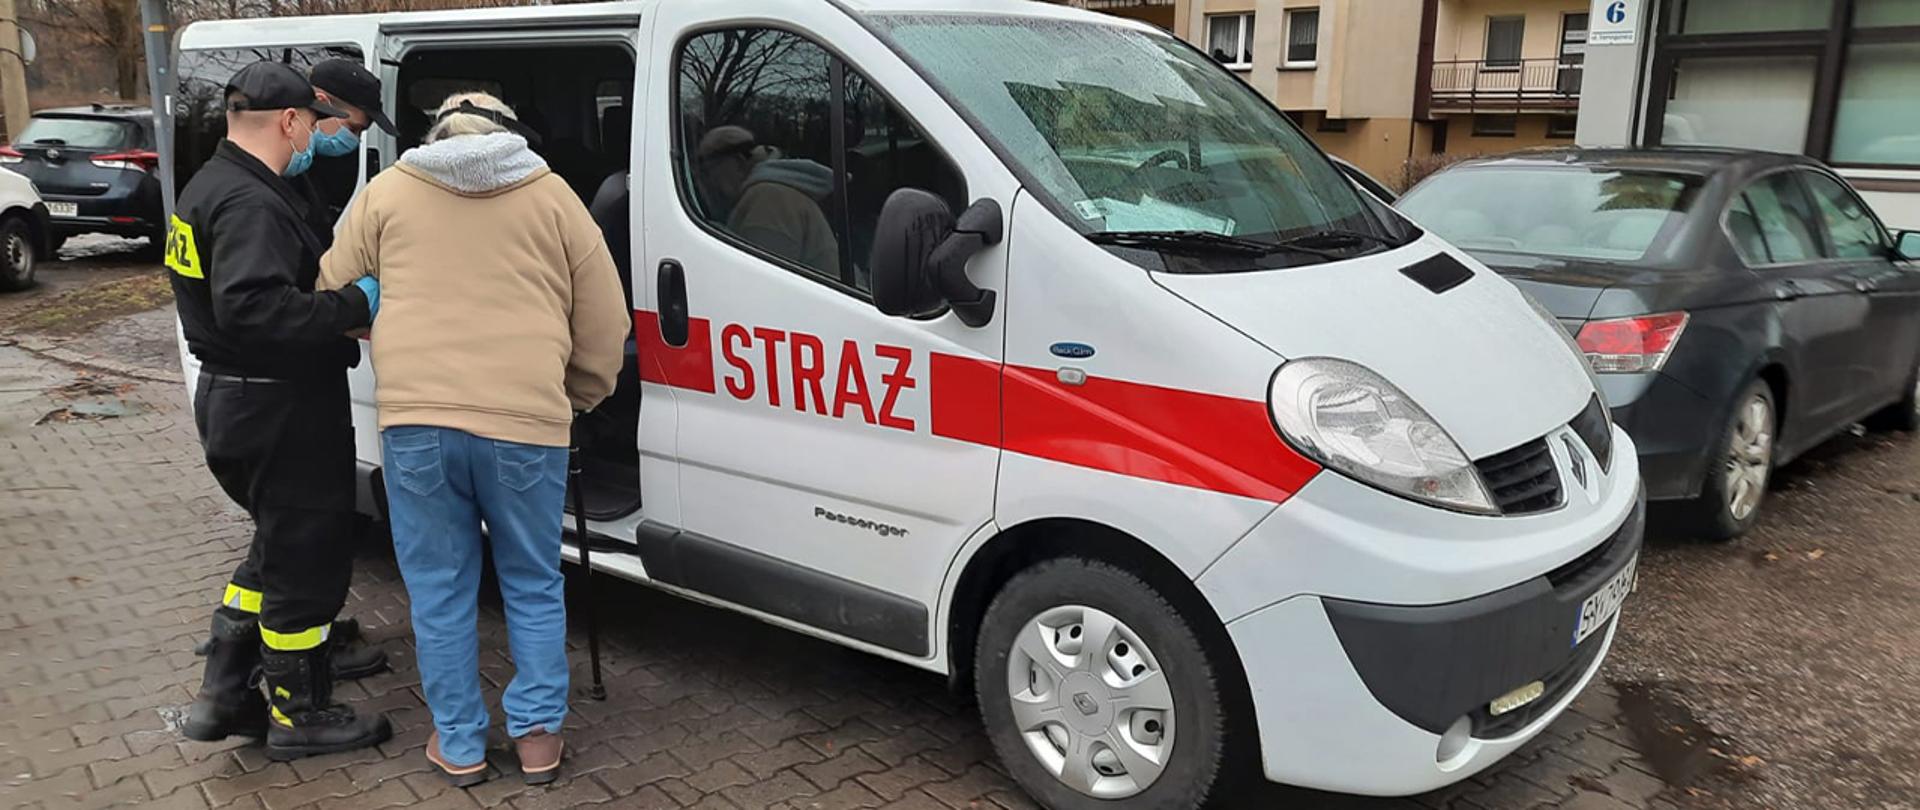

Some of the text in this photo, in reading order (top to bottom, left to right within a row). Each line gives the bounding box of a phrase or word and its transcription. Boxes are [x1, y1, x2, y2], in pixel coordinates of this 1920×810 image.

[1606, 2, 1625, 24] 6
[721, 323, 916, 432] STRAŻ
[814, 506, 910, 538] Passenger
